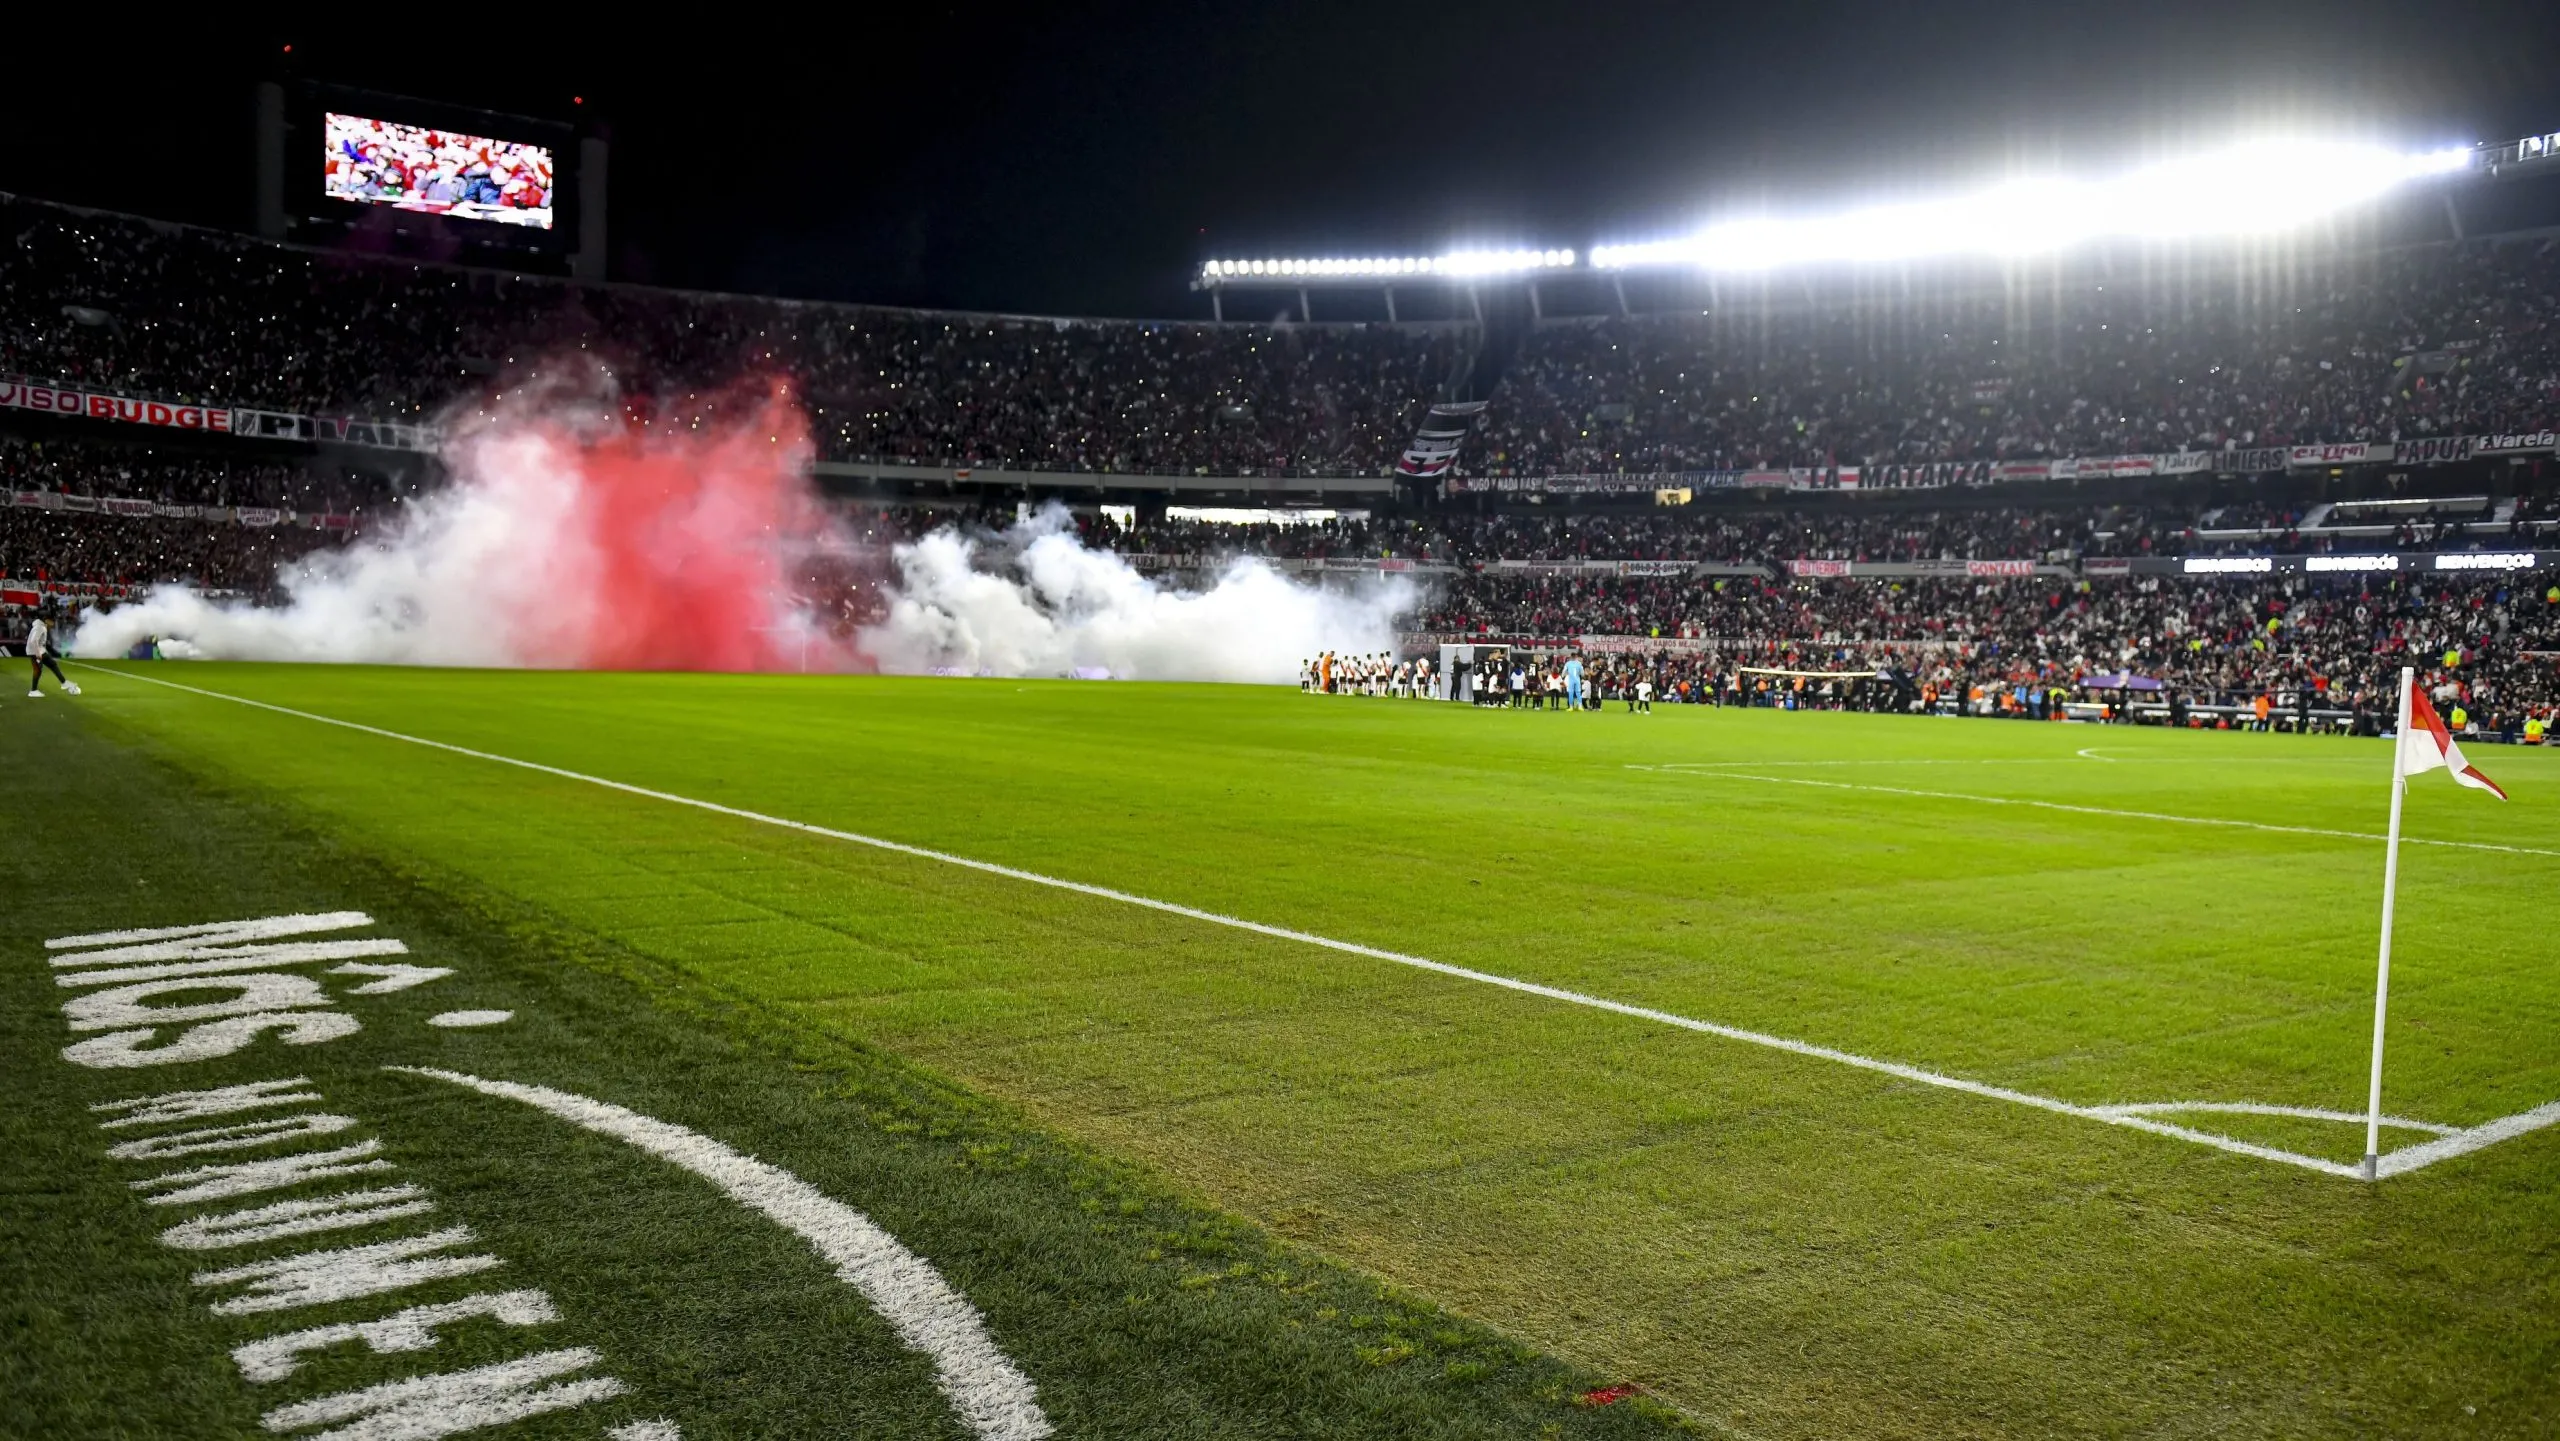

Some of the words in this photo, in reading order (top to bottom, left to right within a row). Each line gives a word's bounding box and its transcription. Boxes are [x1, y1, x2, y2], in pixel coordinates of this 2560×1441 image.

[89, 396, 229, 431] BUDGE
[2394, 438, 2471, 463] PADUA
[1810, 467, 1841, 489] LA
[1858, 461, 1992, 488] MATANZA
[90, 1074, 684, 1441] MONUMEN
